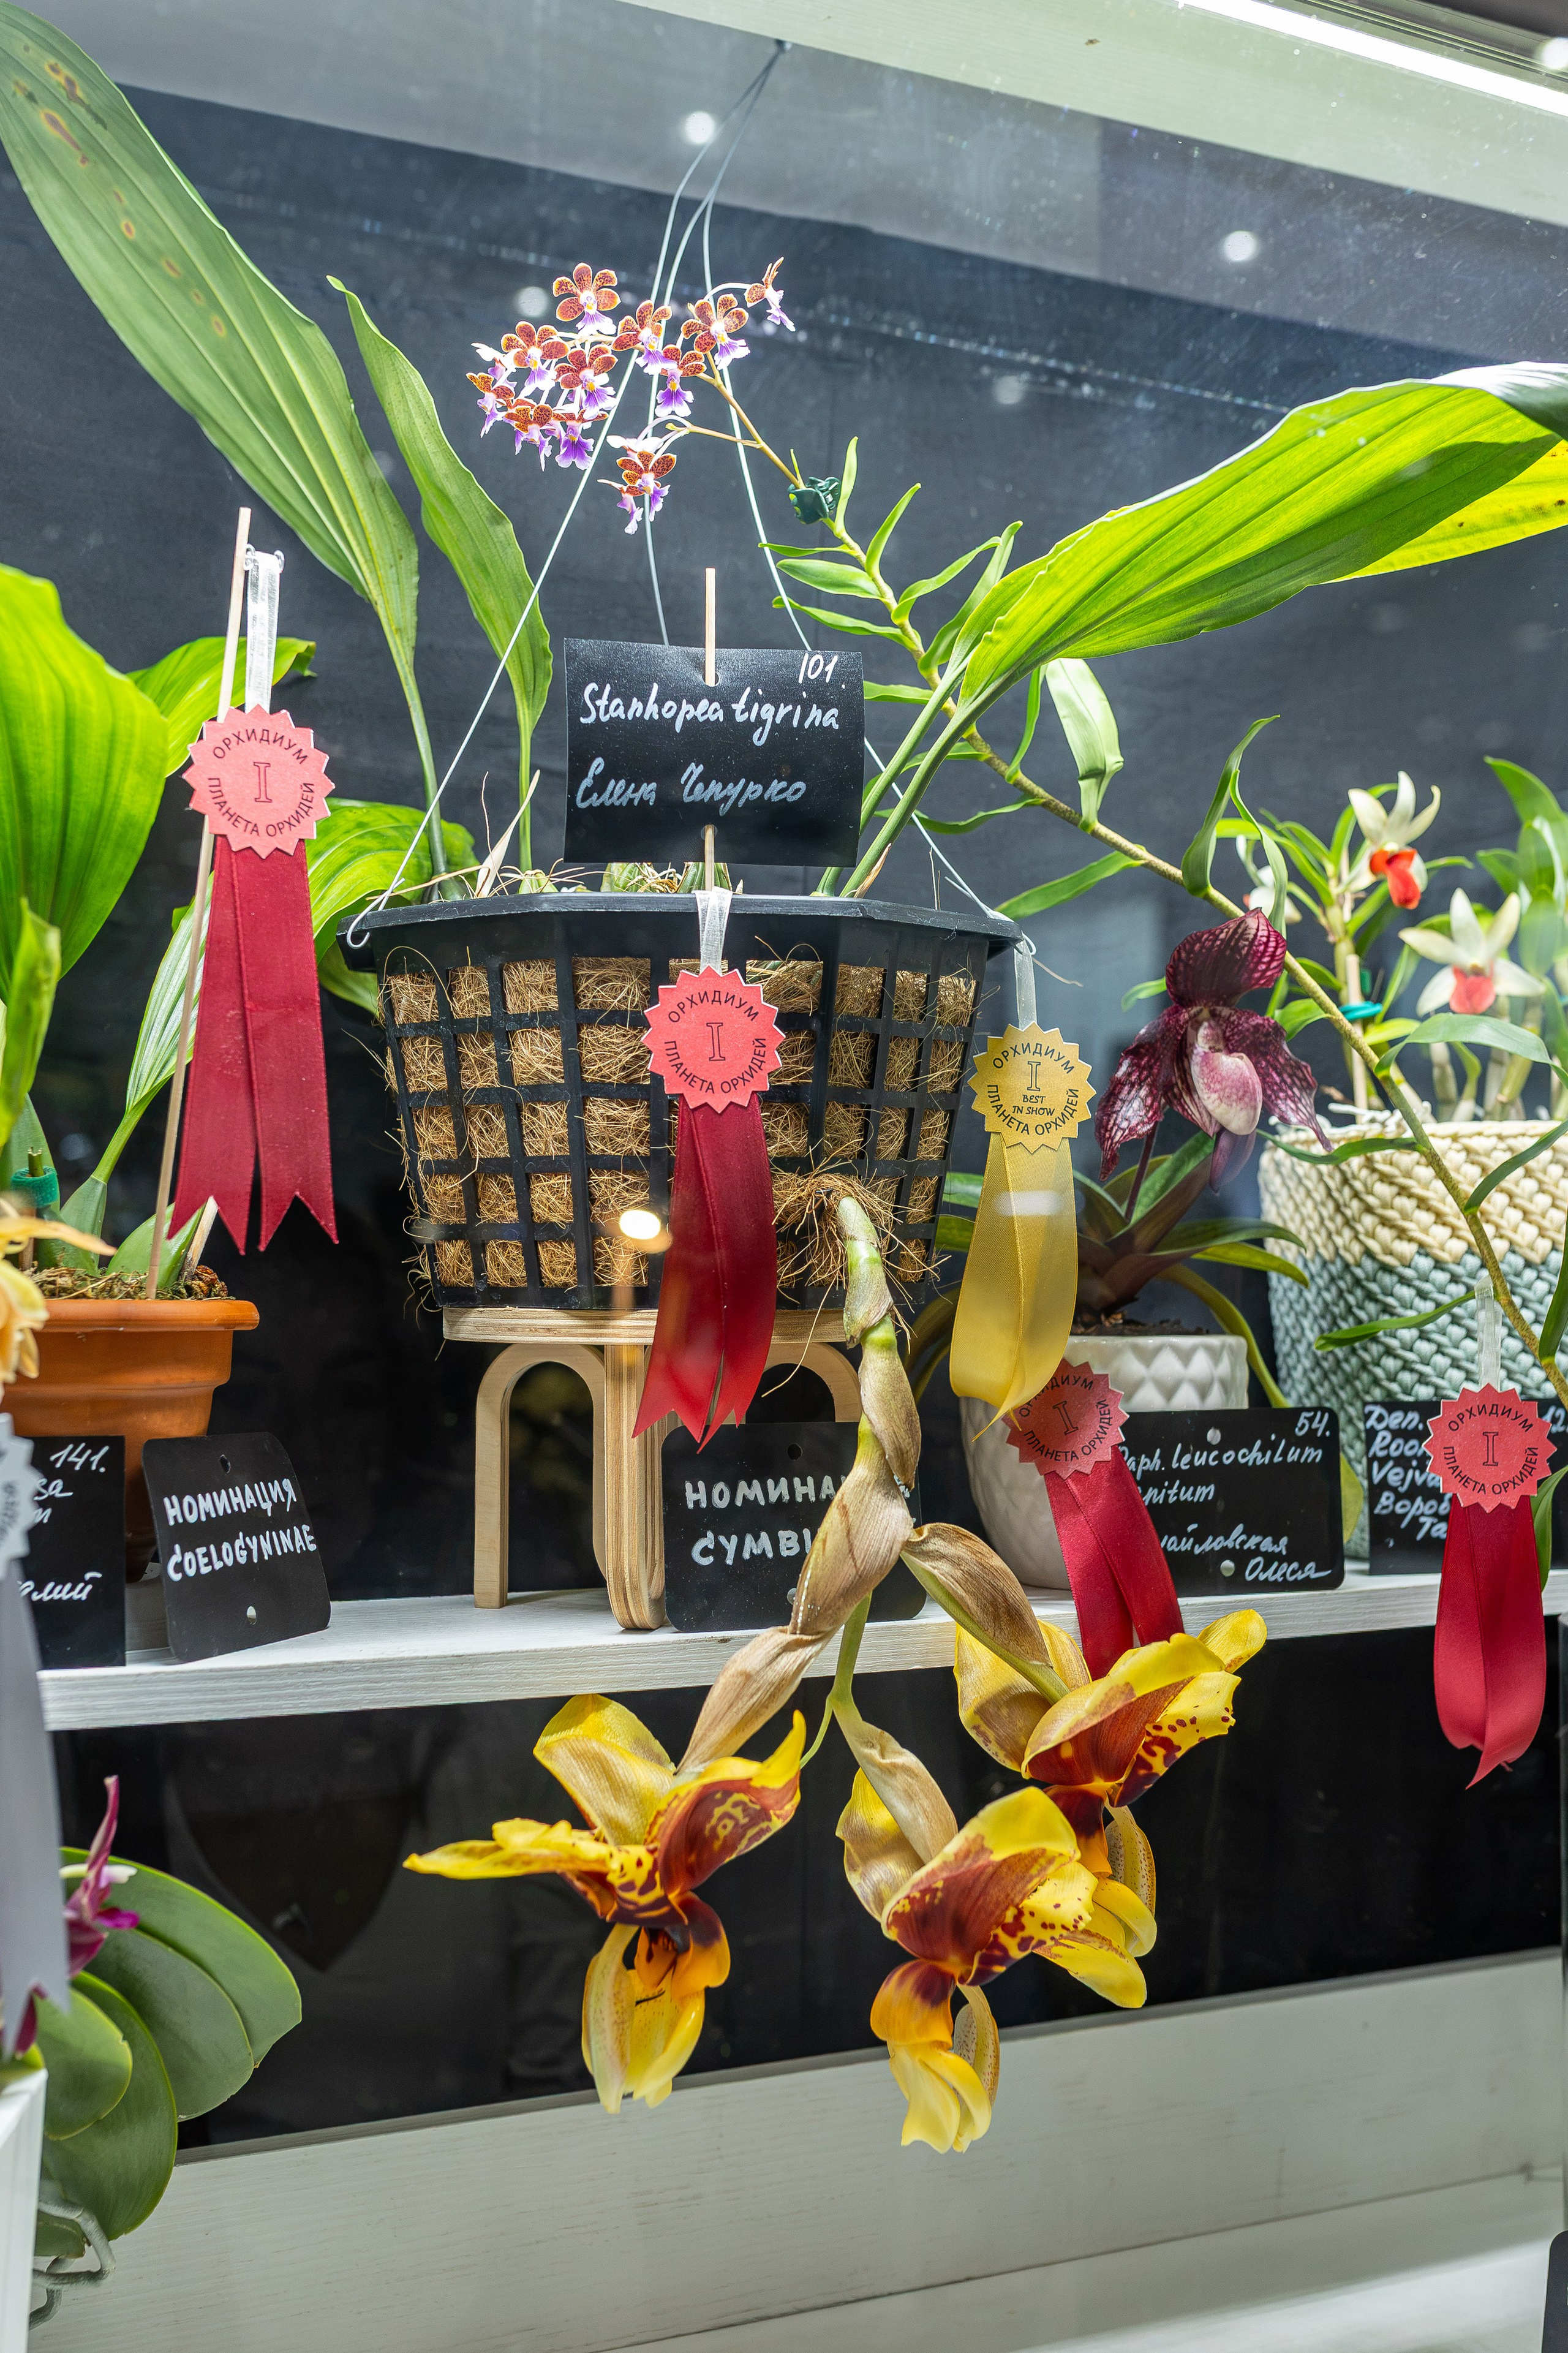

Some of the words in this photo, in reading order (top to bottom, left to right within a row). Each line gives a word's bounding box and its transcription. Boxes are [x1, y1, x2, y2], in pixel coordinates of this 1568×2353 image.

[579, 682, 724, 733] Stanhopea
[731, 687, 839, 746] tigrina
[213, 729, 308, 765] ОРХИДИУМ
[253, 761, 273, 803] I
[575, 757, 657, 809] Елена
[680, 762, 807, 817] Чепурко
[208, 777, 260, 836] ПЛАНЕТА
[266, 782, 315, 837] ОРХИДЕЙ
[668, 990, 759, 1022] ОРХИДИУМ
[706, 1022, 726, 1061] I
[993, 1043, 1075, 1074] ОРХИДИУМ
[665, 1040, 715, 1093] ПЛАНЕТА
[720, 1038, 766, 1093] ОРХИДЕЙ
[1027, 1060, 1041, 1092] I
[987, 1084, 1030, 1135] ПЛАНЕТА
[1035, 1088, 1079, 1136] ОРХИДЕЙ
[1012, 1105, 1023, 1114] IN
[1025, 1106, 1055, 1116] SHOW
[1022, 1094, 1046, 1104] BEST
[1023, 1430, 1079, 1462] ПЛАНЕТА
[1081, 1399, 1113, 1456] ОРХИДЕЙ
[1053, 1400, 1079, 1435] I
[1363, 1403, 1424, 1431] Den.
[1448, 1403, 1534, 1432] ОРХИДИУМ
[1171, 1433, 1323, 1471] leucochilum
[1368, 1429, 1430, 1459] Roo
[1482, 1431, 1499, 1467] I
[1443, 1446, 1487, 1495] ПЛАНЕТА
[1491, 1447, 1539, 1495] ОРХИДЕЙ
[163, 1478, 297, 1526] НОМИНАЦИЯ
[167, 1524, 317, 1582] COELOGYNINAE
[1245, 1555, 1332, 1582] Олеся
